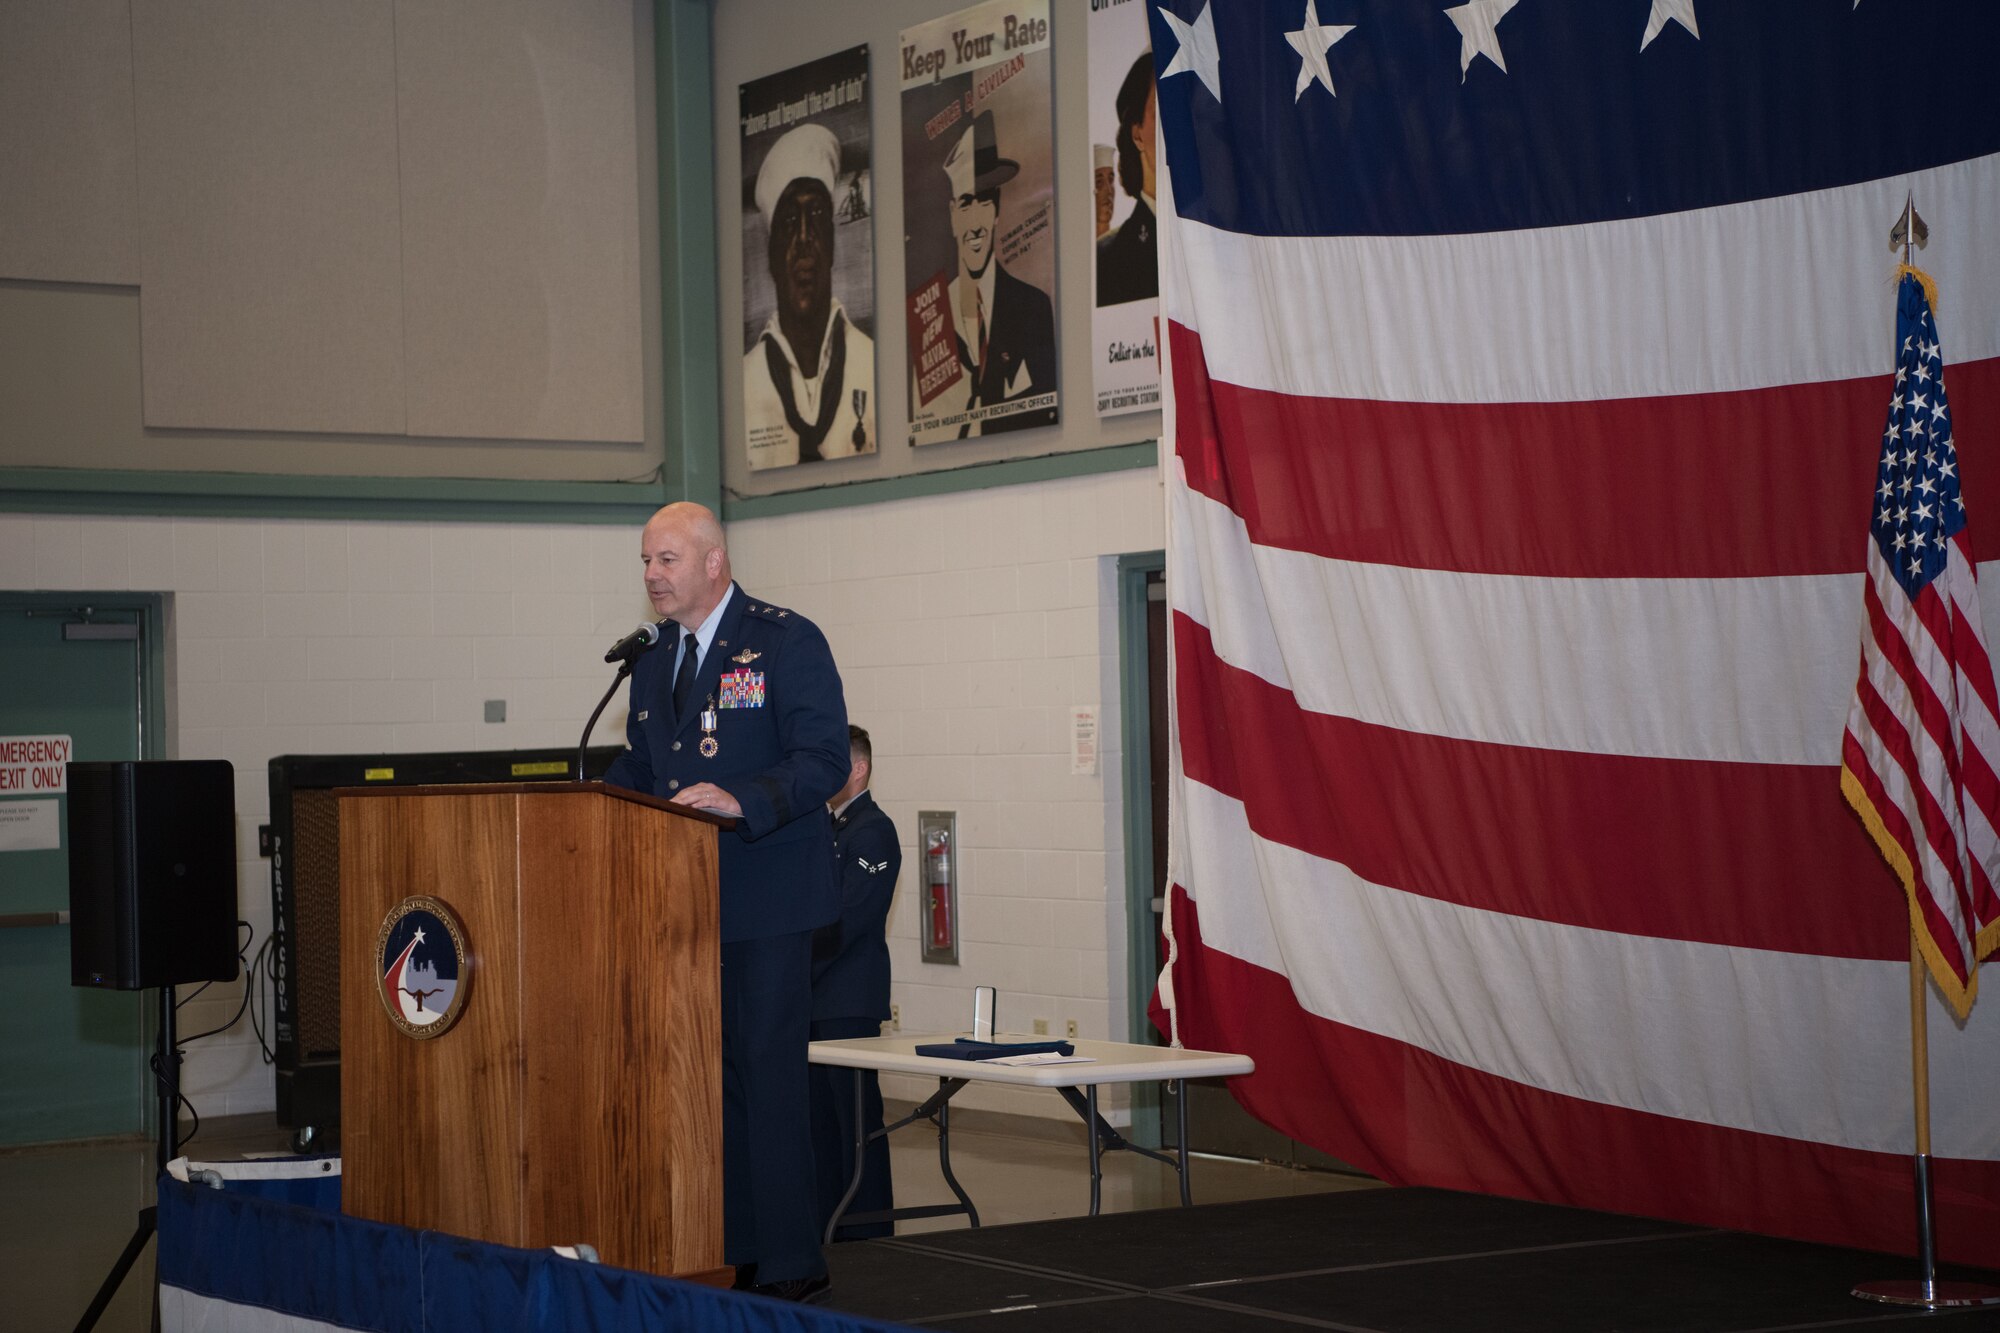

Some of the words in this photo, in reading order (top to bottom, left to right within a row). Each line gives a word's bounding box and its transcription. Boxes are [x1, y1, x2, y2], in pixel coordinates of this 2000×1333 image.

[902, 45, 946, 84] Keep
[953, 29, 994, 64] Your
[1004, 15, 1047, 50] Rate
[977, 53, 1025, 99] CIVILIAN
[768, 103, 781, 129] and
[781, 94, 808, 126] beyond
[809, 92, 822, 115] the
[823, 84, 836, 110] call
[837, 81, 846, 106] of
[914, 282, 941, 314] JOIN
[921, 304, 937, 325] THE
[922, 313, 945, 351] NEW
[921, 339, 951, 373] NAVAL
[1109, 341, 1131, 363] Enlist
[1133, 343, 1141, 359] in
[1143, 339, 1155, 358] the
[920, 355, 959, 397] RESERVE
[912, 423, 922, 433] SEE
[924, 420, 940, 431] YOUR
[942, 413, 969, 426] NEAREST
[970, 410, 989, 422] NAVY
[990, 401, 1027, 416] RECRUITING
[1029, 395, 1054, 408] OFFICER
[1112, 394, 1138, 409] RECRUITING
[1141, 391, 1159, 405] STATION
[0, 767, 26, 789] EXIT
[32, 766, 63, 789] ONLY
[378, 938, 386, 963] NAVY
